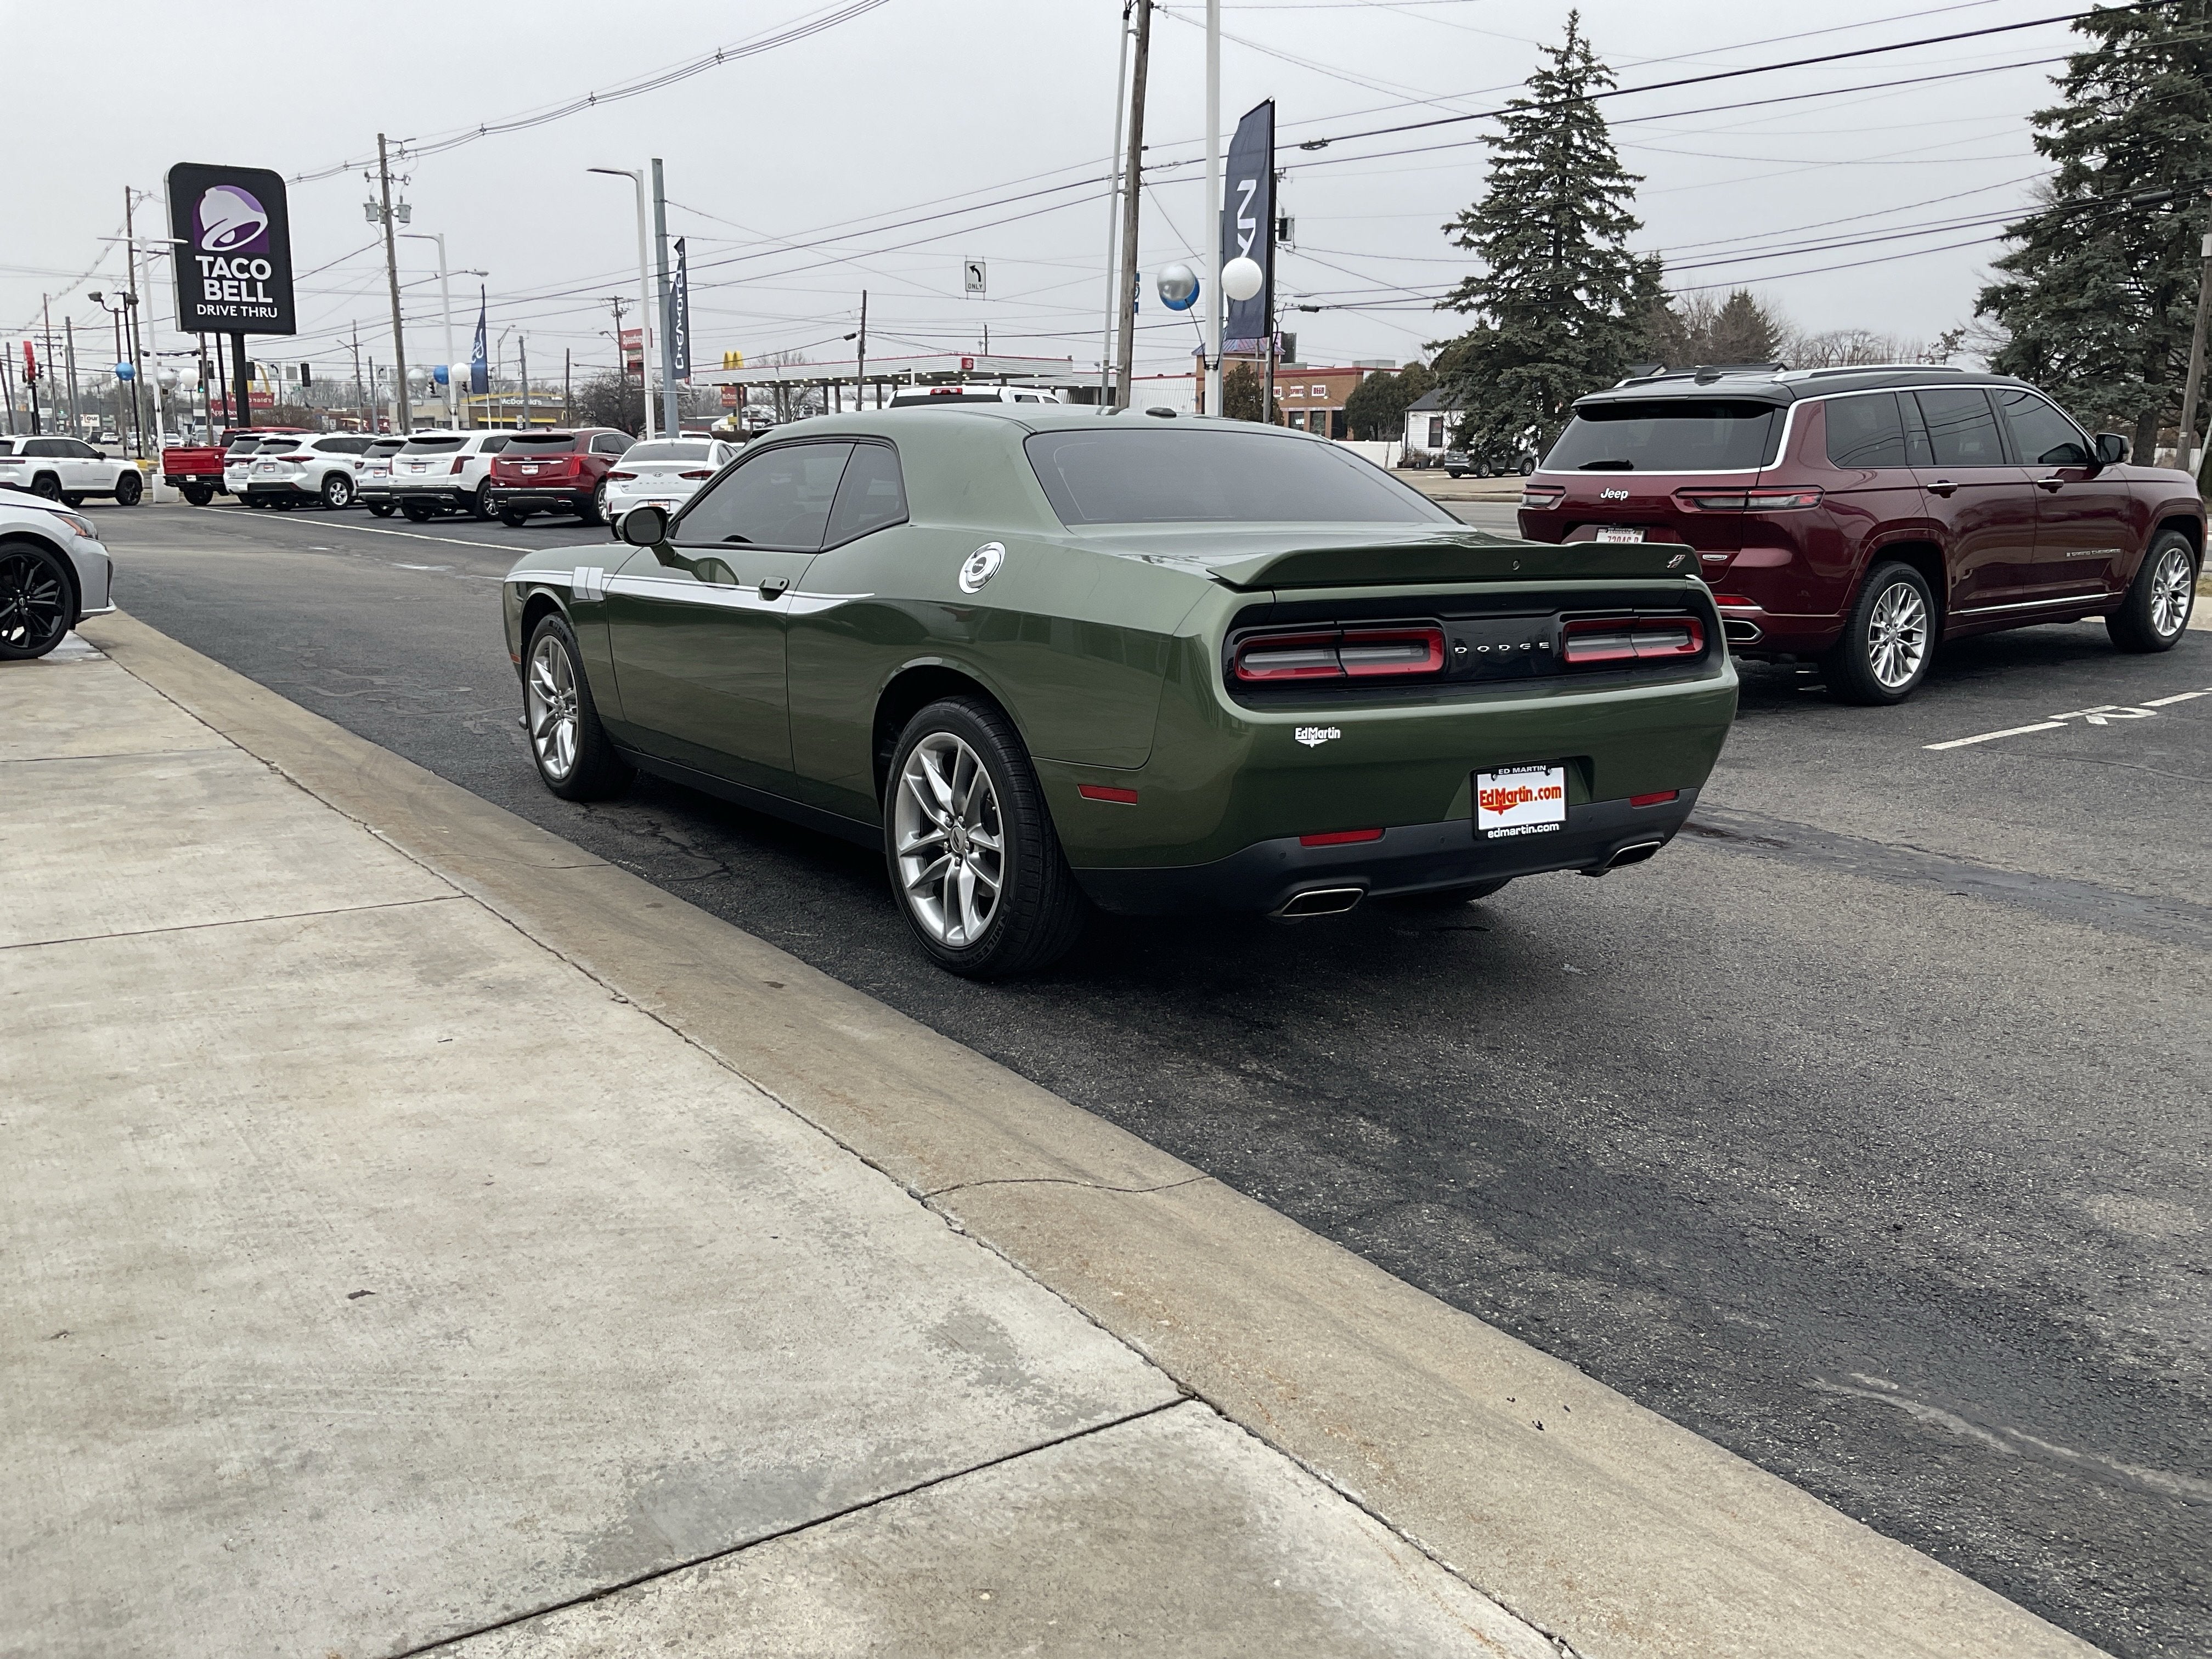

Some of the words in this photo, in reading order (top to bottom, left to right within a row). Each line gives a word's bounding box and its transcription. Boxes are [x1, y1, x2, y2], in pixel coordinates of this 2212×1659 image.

[195, 255, 272, 280] TACO
[204, 279, 273, 303] BELL
[196, 304, 238, 316] DRIVE
[240, 306, 278, 318] THRU
[1600, 488, 1629, 501] Jeep
[1454, 642, 1549, 654] DODGE
[1295, 727, 1340, 741] EdMartin
[1513, 765, 1546, 774] MARTIN
[1480, 785, 1561, 807] EdMartin.com
[1487, 823, 1559, 838] edmartin.com
